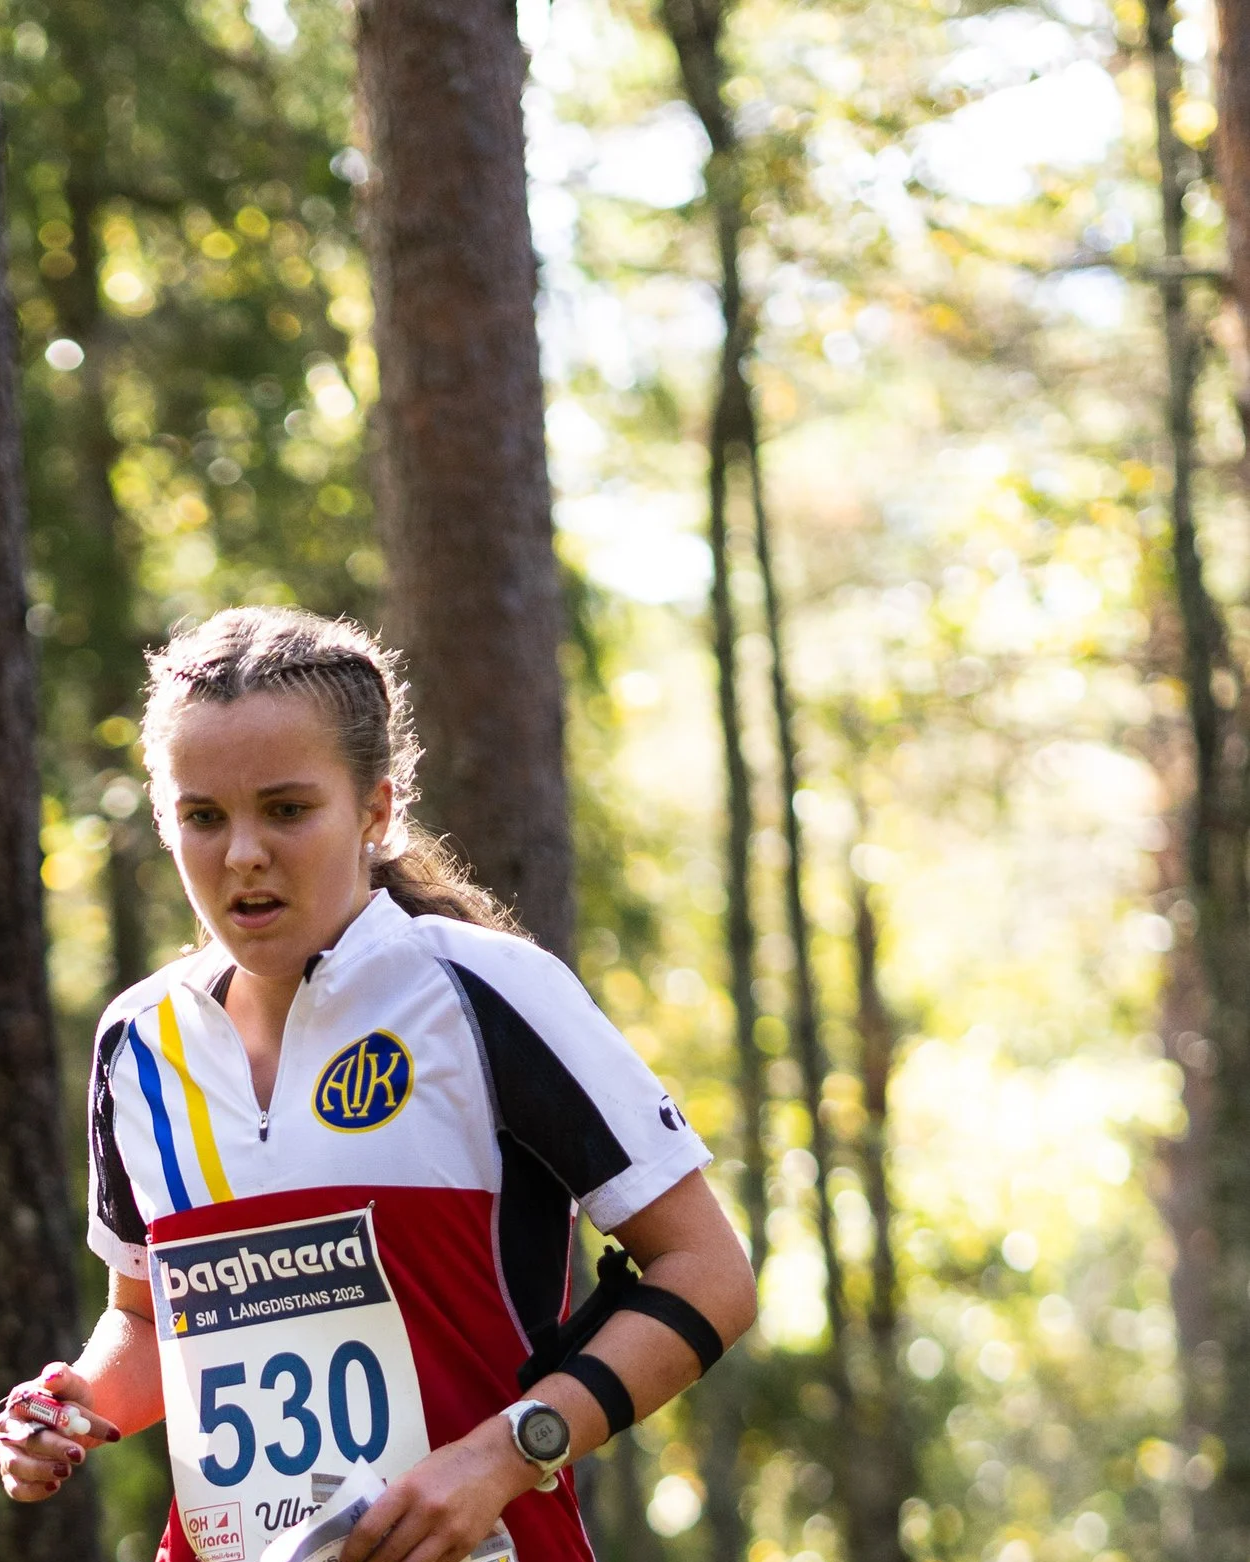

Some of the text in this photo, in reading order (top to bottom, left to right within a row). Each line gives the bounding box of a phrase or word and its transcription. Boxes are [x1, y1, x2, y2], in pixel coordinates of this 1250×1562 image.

[321, 1040, 401, 1118] AIK
[159, 1236, 366, 1299] bagheera
[196, 1285, 365, 1327] SM LÅNGDISTANS 2025
[198, 1340, 390, 1488] 530
